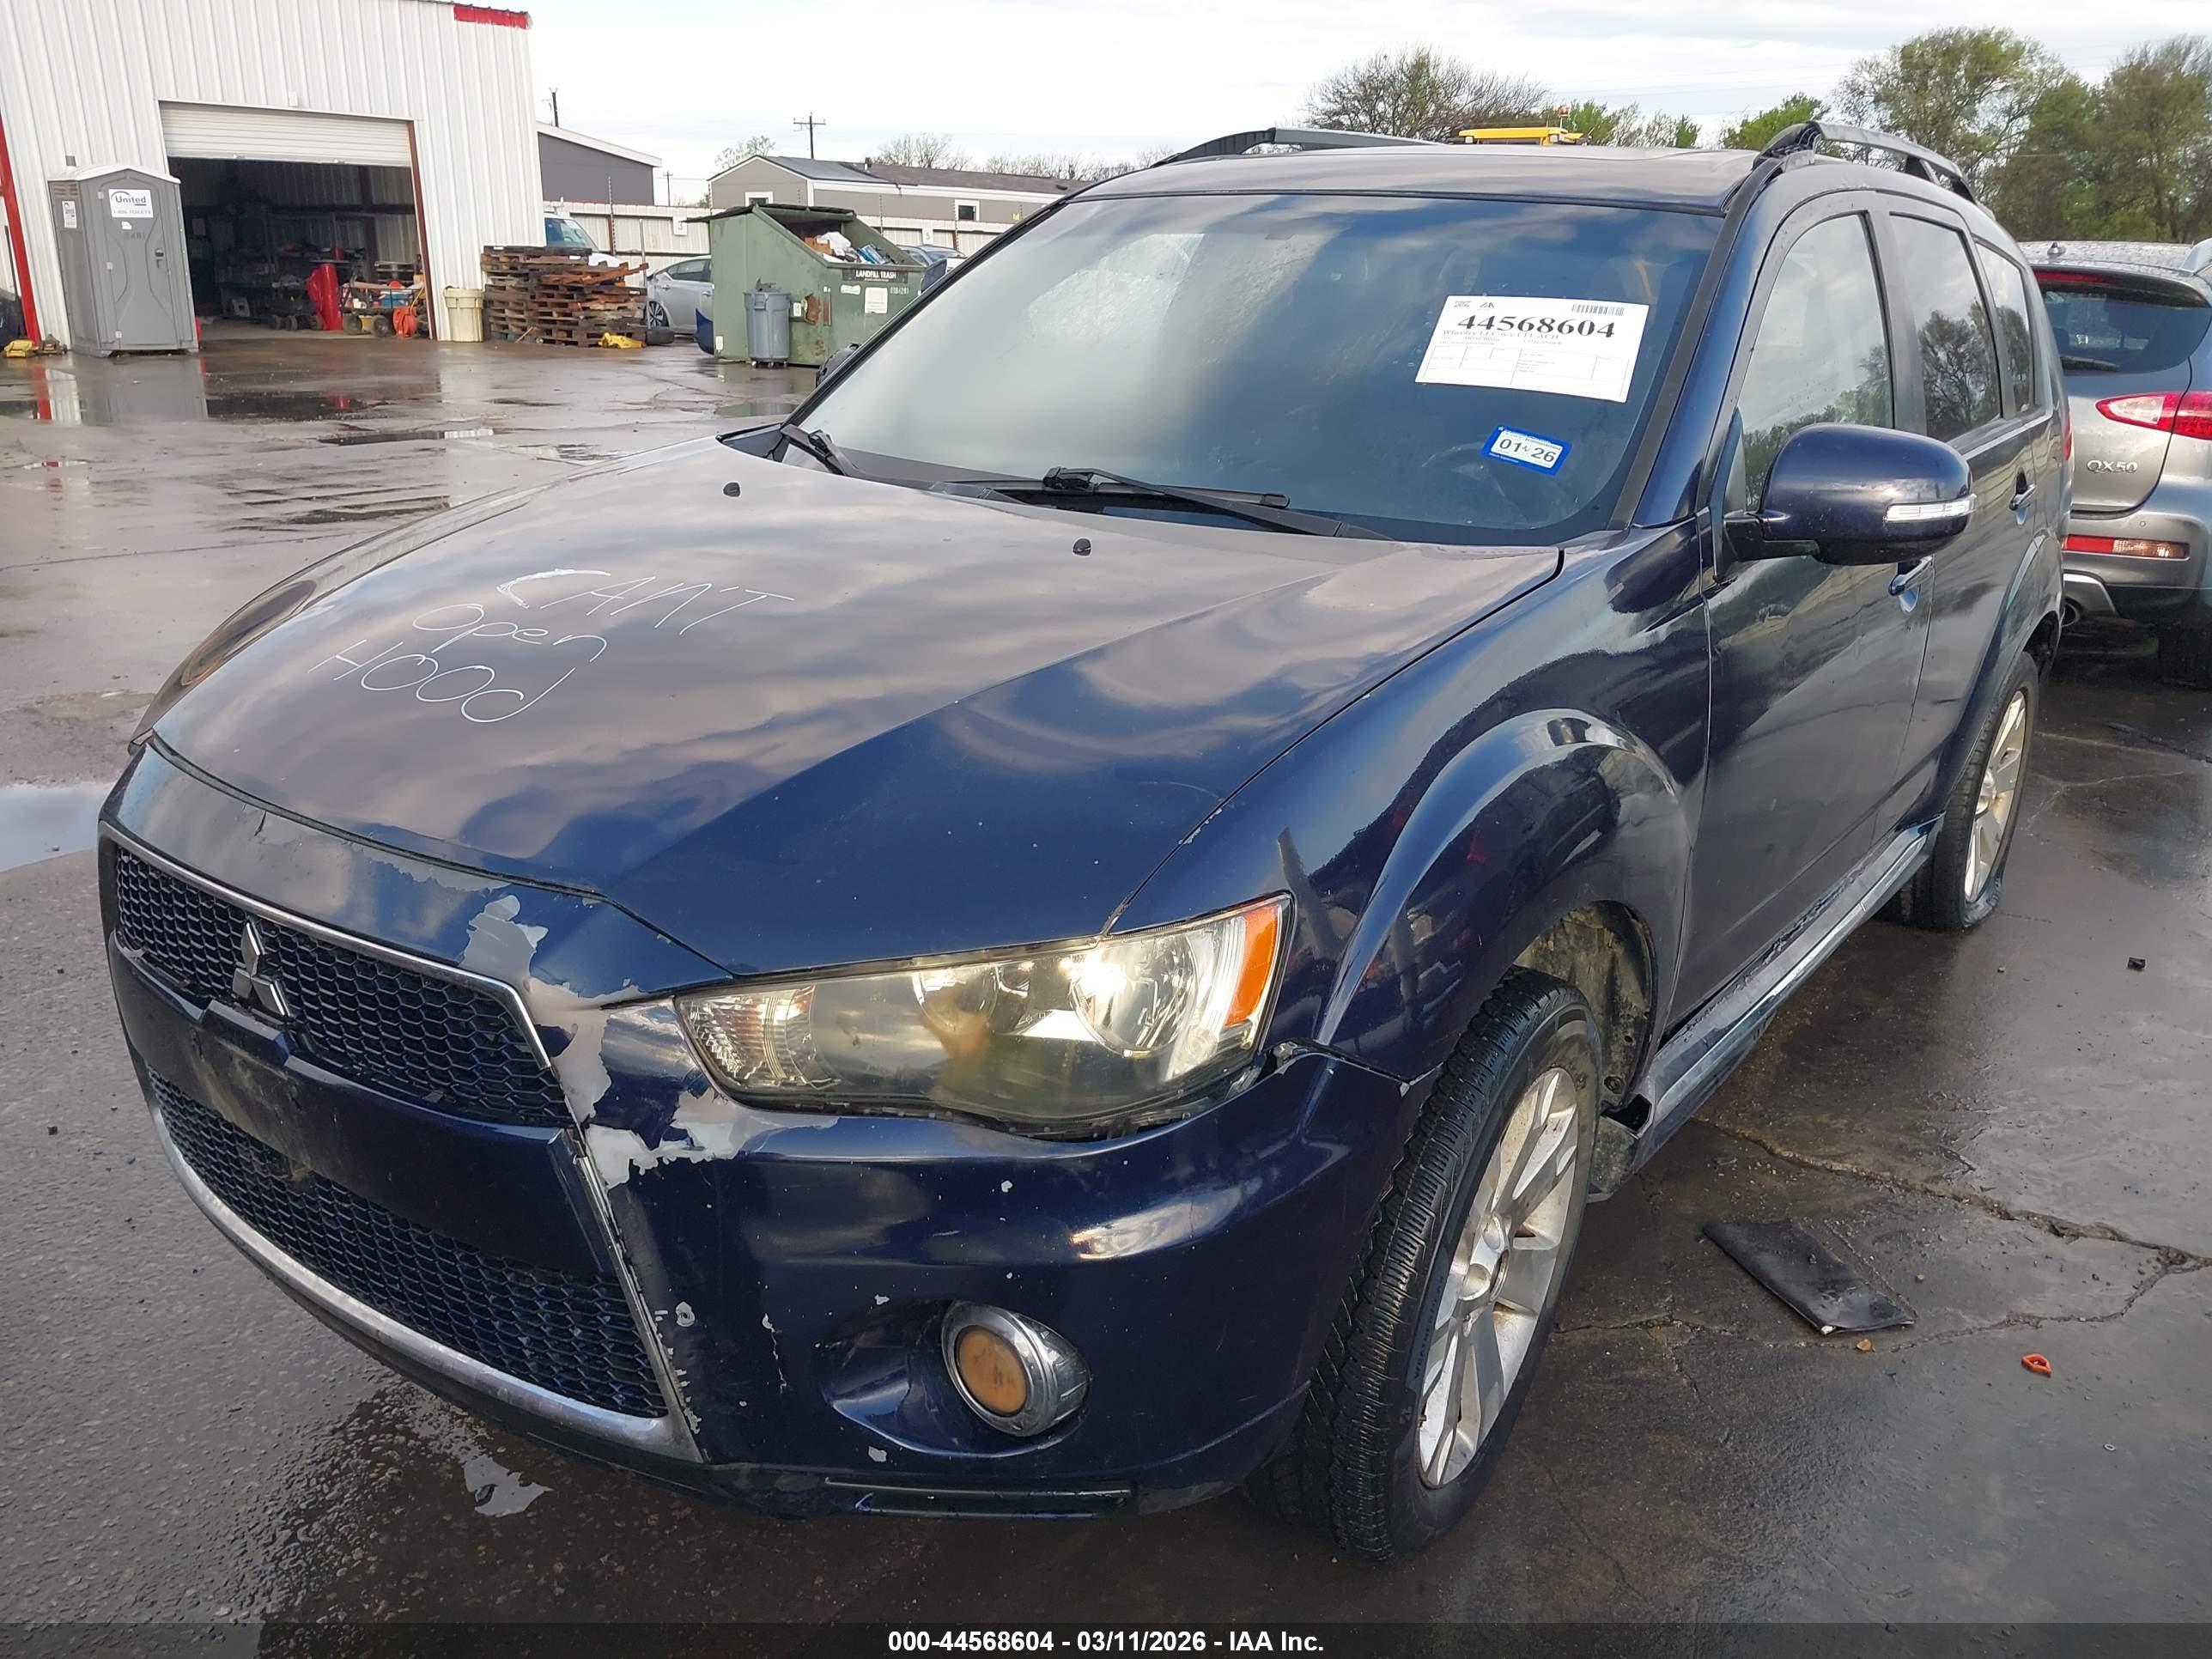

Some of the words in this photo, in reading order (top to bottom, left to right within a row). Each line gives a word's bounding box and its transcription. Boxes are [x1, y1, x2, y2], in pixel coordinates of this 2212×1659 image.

[855, 270, 879, 278] LANDFILL
[880, 271, 896, 280] TRASH
[1457, 314, 1614, 338] 44568604
[1499, 439, 1522, 453] 01
[1530, 447, 1558, 463] 26
[2087, 459, 2138, 473] QX50
